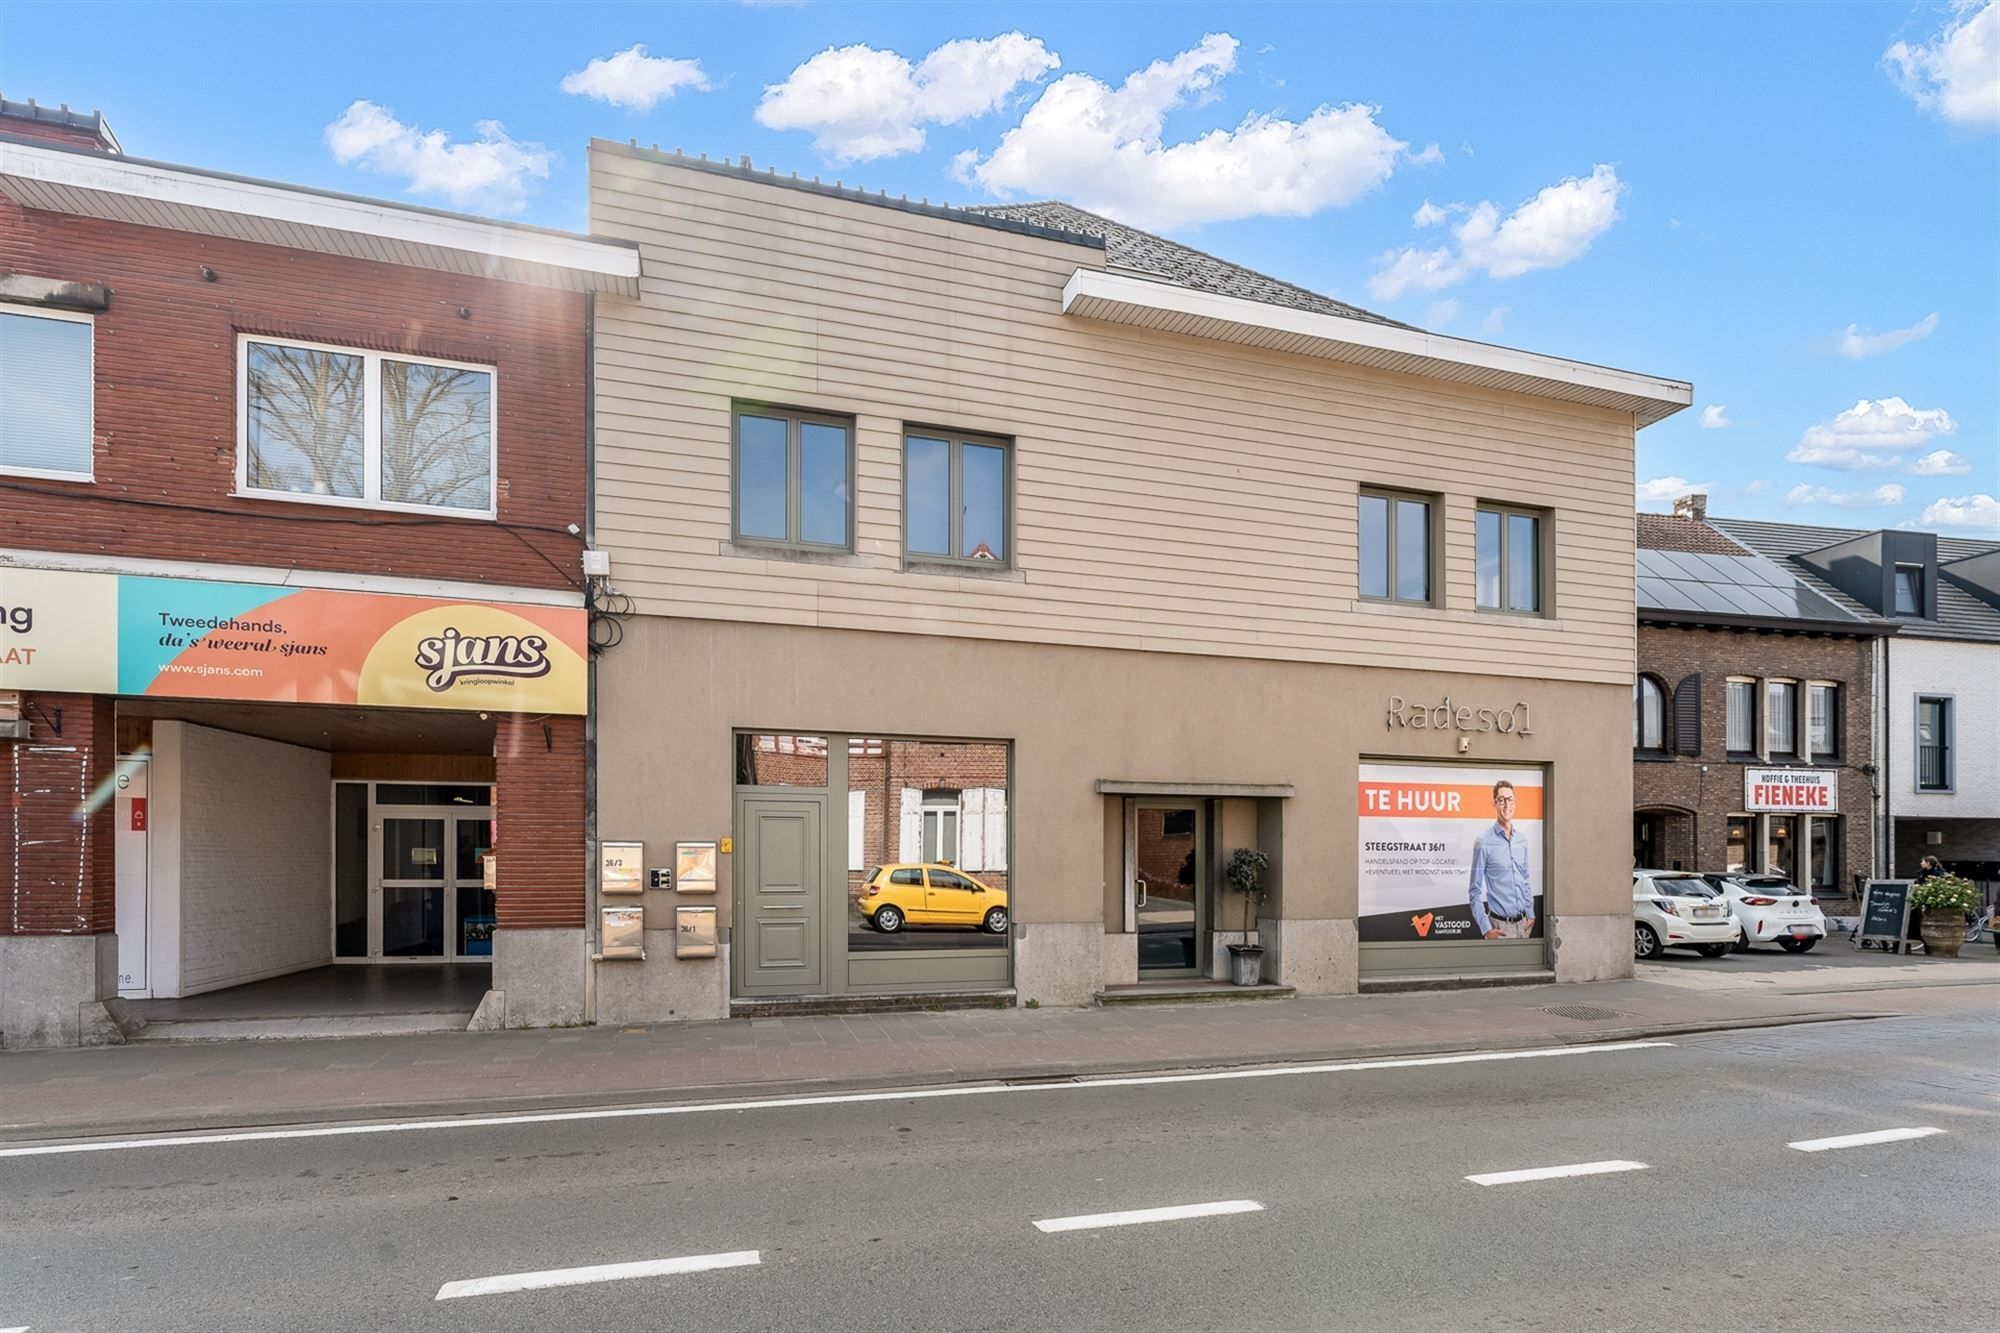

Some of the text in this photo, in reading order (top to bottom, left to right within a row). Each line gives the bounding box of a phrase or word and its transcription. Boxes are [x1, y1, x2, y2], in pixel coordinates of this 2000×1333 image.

[159, 612, 287, 634] Tweedehands,
[207, 638, 276, 653] weeral
[279, 640, 328, 657] sjans
[415, 627, 551, 692] sjans
[158, 663, 264, 677] www.sjans.com
[1761, 775, 1783, 784] KOFFIE
[1791, 775, 1821, 784] THEEHUIS
[1365, 788, 1462, 812] TE HUUR
[1754, 784, 1828, 806] FIENEKE
[1365, 842, 1446, 852] STEEGSTRAAT 36/1
[605, 859, 623, 867] 36/3
[681, 925, 696, 933] 36/1
[1434, 920, 1471, 929] VASTGOED
